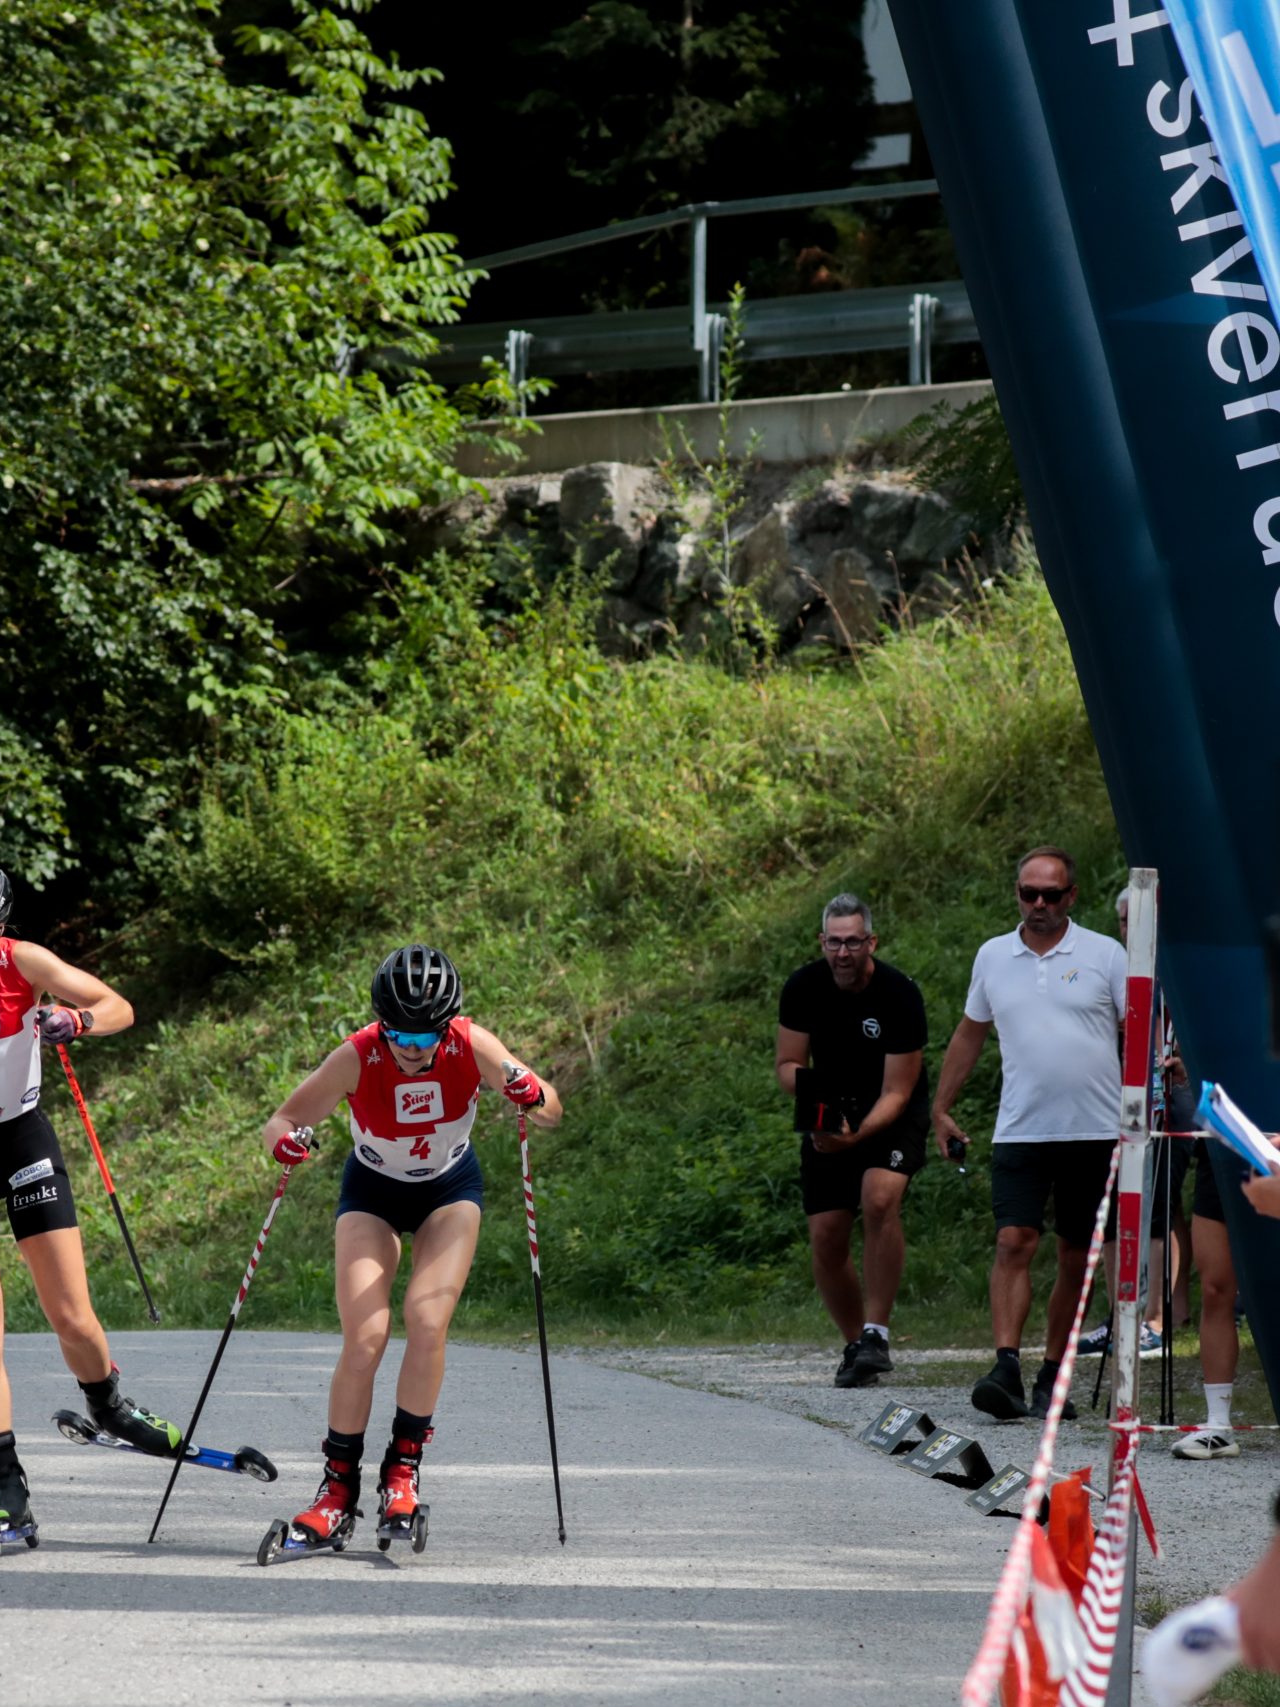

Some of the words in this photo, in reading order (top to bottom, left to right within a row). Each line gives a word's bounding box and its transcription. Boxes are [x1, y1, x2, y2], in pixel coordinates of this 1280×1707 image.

[401, 1090, 435, 1112] Stiegl
[409, 1136, 431, 1160] 4
[13, 1185, 58, 1207] frisikt
